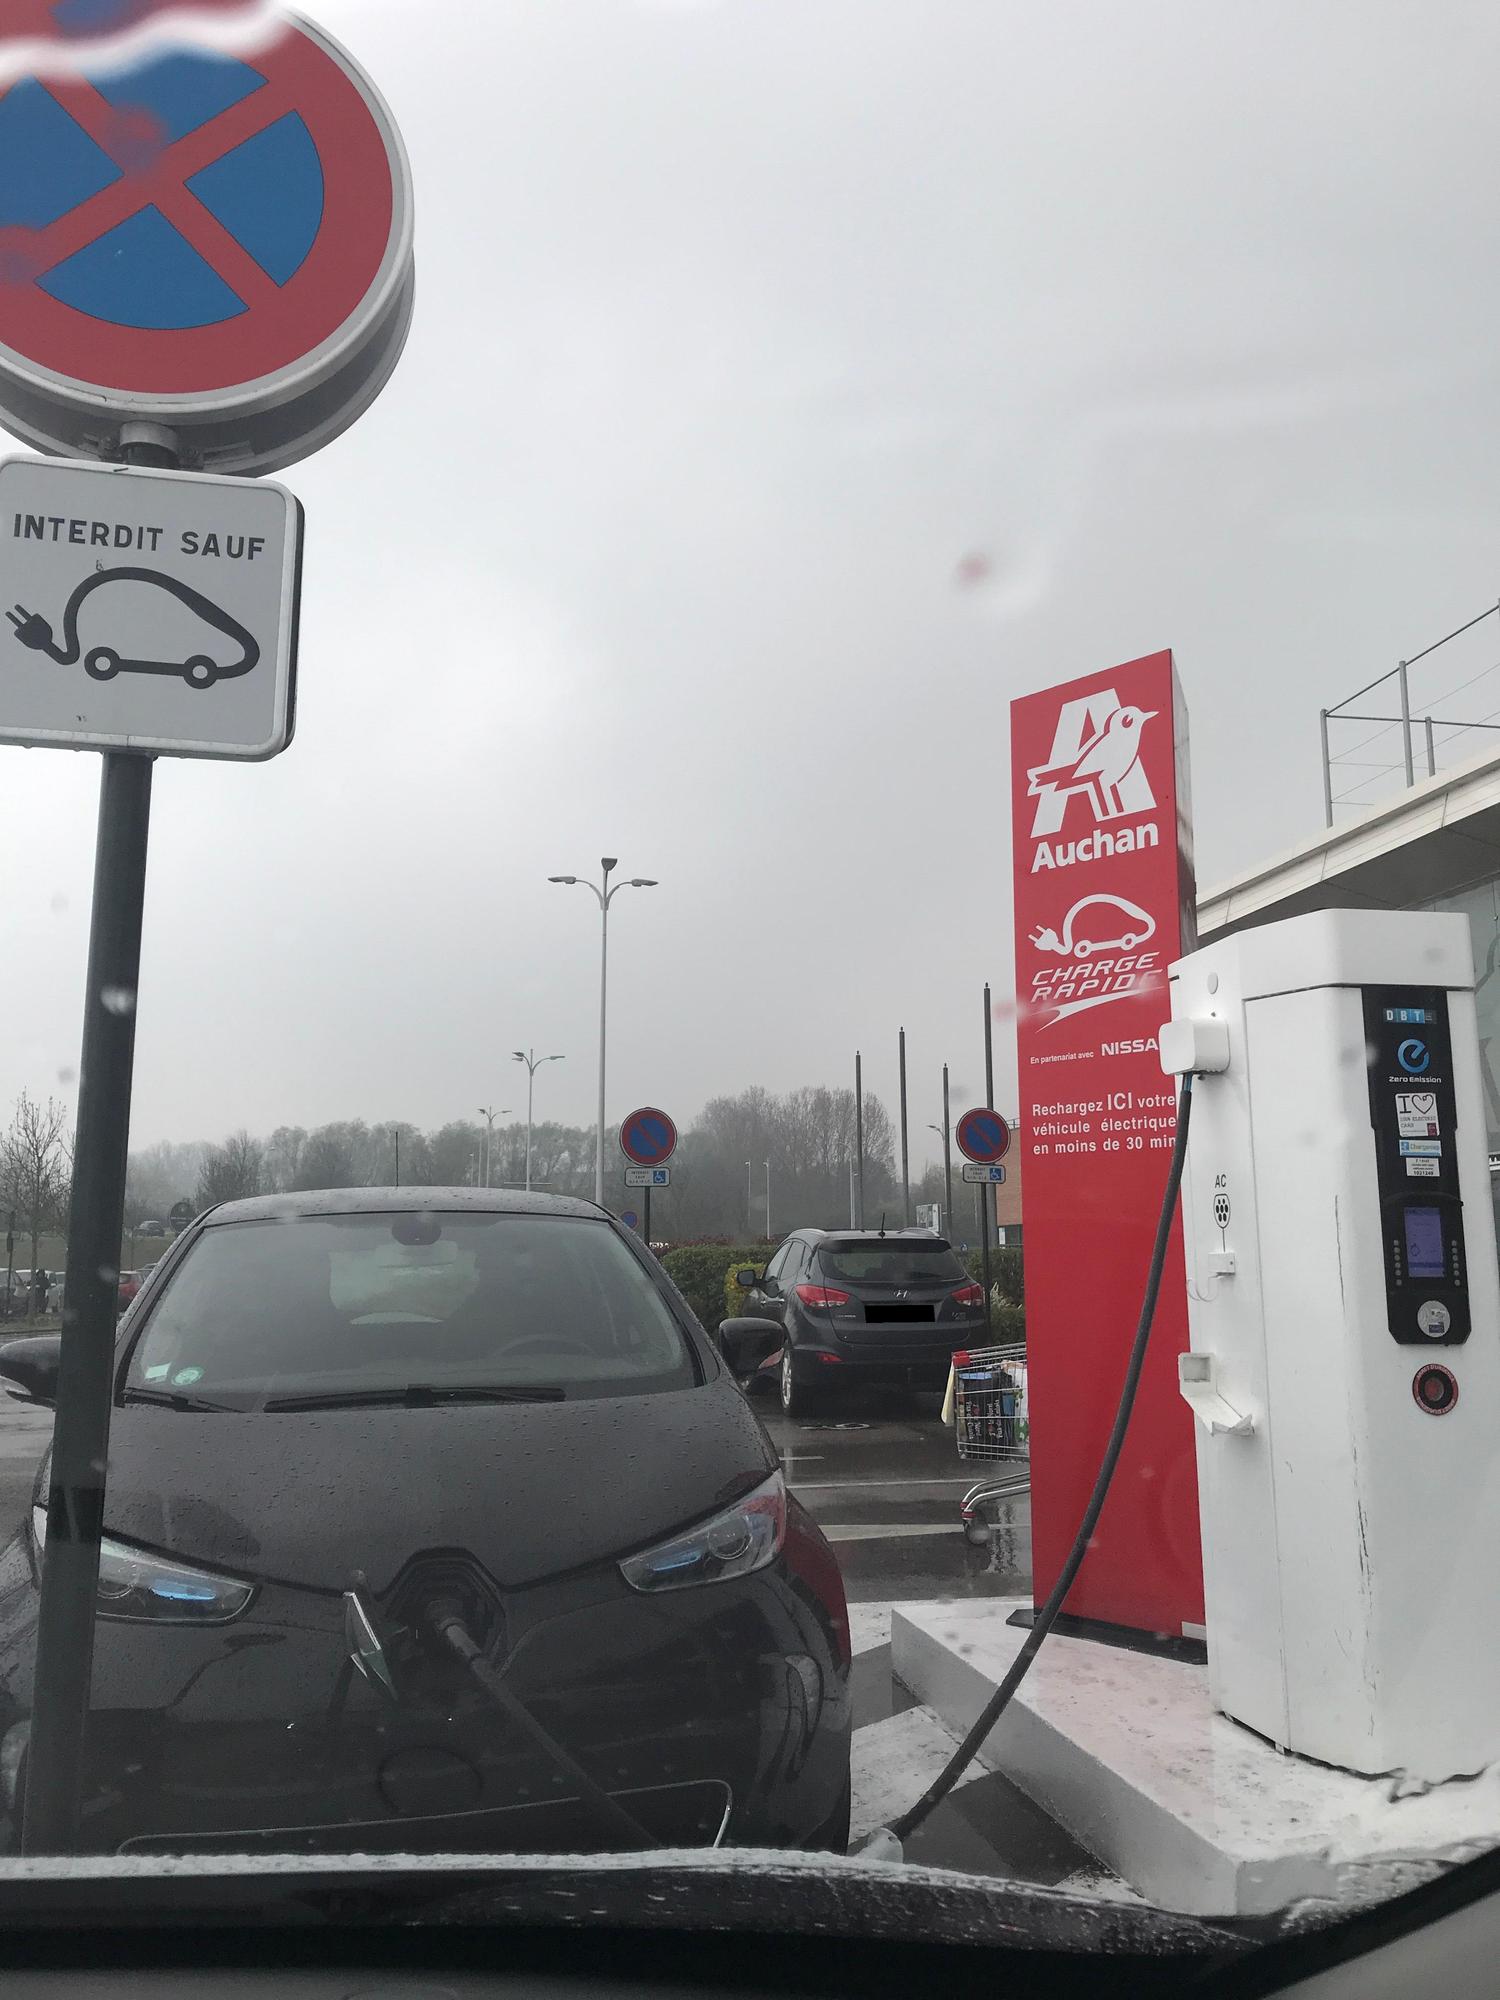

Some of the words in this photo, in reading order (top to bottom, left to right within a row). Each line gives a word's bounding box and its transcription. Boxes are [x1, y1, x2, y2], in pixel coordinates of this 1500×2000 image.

[13, 513, 163, 551] INTERDIT
[180, 531, 265, 560] SAUF
[1030, 821, 1159, 873] Auchan
[1032, 951, 1160, 986] CHARGE
[1030, 1056, 1039, 1064] En
[1040, 1052, 1077, 1064] partenariat
[1078, 1051, 1094, 1059] avec
[1101, 1038, 1159, 1056] NISSA
[1409, 1075, 1442, 1083] Emission
[1032, 1102, 1103, 1116] Rechargez
[1107, 1092, 1132, 1110] ICI
[1137, 1095, 1176, 1108] votre
[1397, 1095, 1411, 1113] I
[1033, 1120, 1090, 1136] véhicule
[1100, 1116, 1176, 1131] électrique
[1033, 1143, 1049, 1155] en
[1055, 1139, 1097, 1154] moins
[1103, 1138, 1120, 1151] de
[1126, 1136, 1143, 1150] 30
[1214, 1174, 1227, 1188] AC
